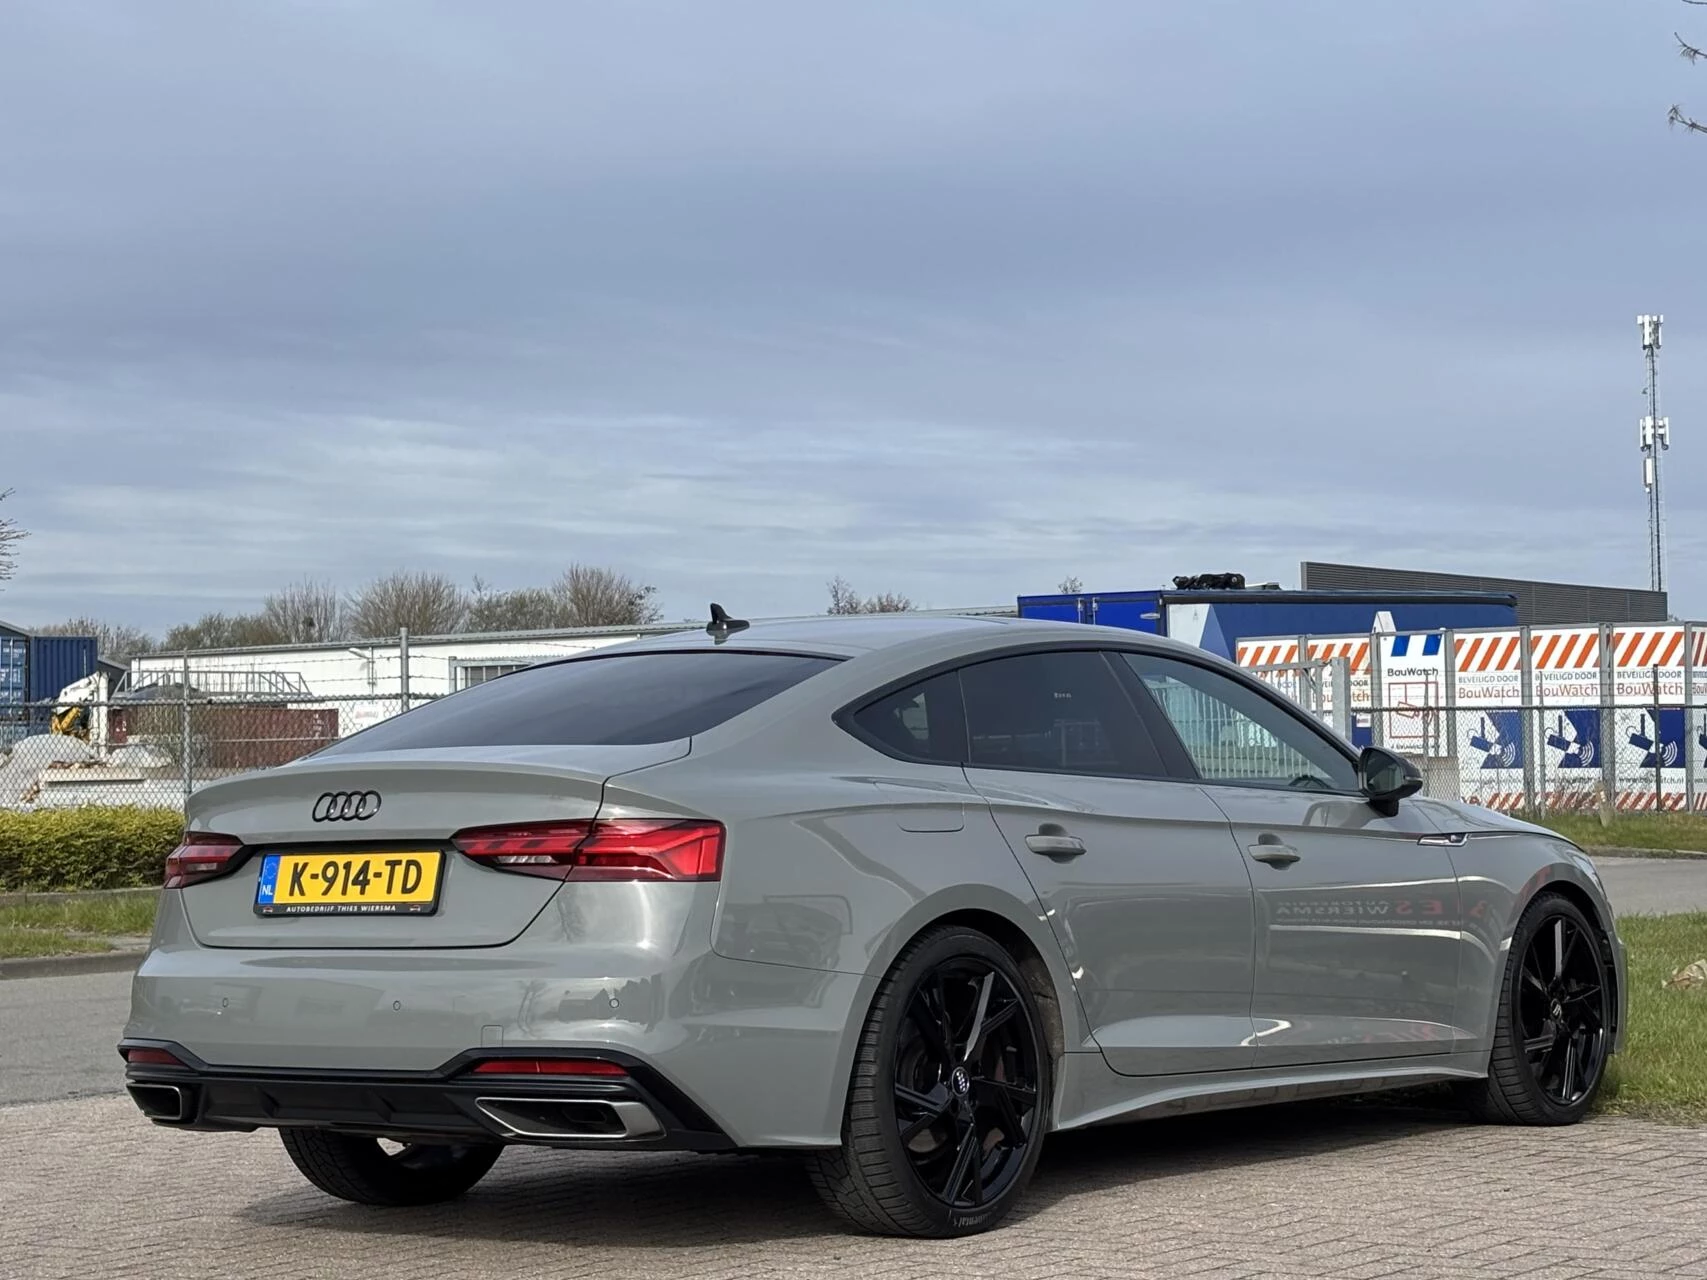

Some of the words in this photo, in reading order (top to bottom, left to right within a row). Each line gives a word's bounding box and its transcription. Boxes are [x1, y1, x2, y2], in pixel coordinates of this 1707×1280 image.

[1497, 674, 1518, 682] DOOR
[1535, 672, 1573, 681] BVEILIGD
[1575, 672, 1597, 680] DOOR
[1658, 671, 1682, 679] DOOR
[1458, 685, 1520, 699] BouWatch
[262, 884, 274, 896] NL
[289, 859, 422, 896] K-914-TD
[361, 904, 396, 912] WIERSMA
